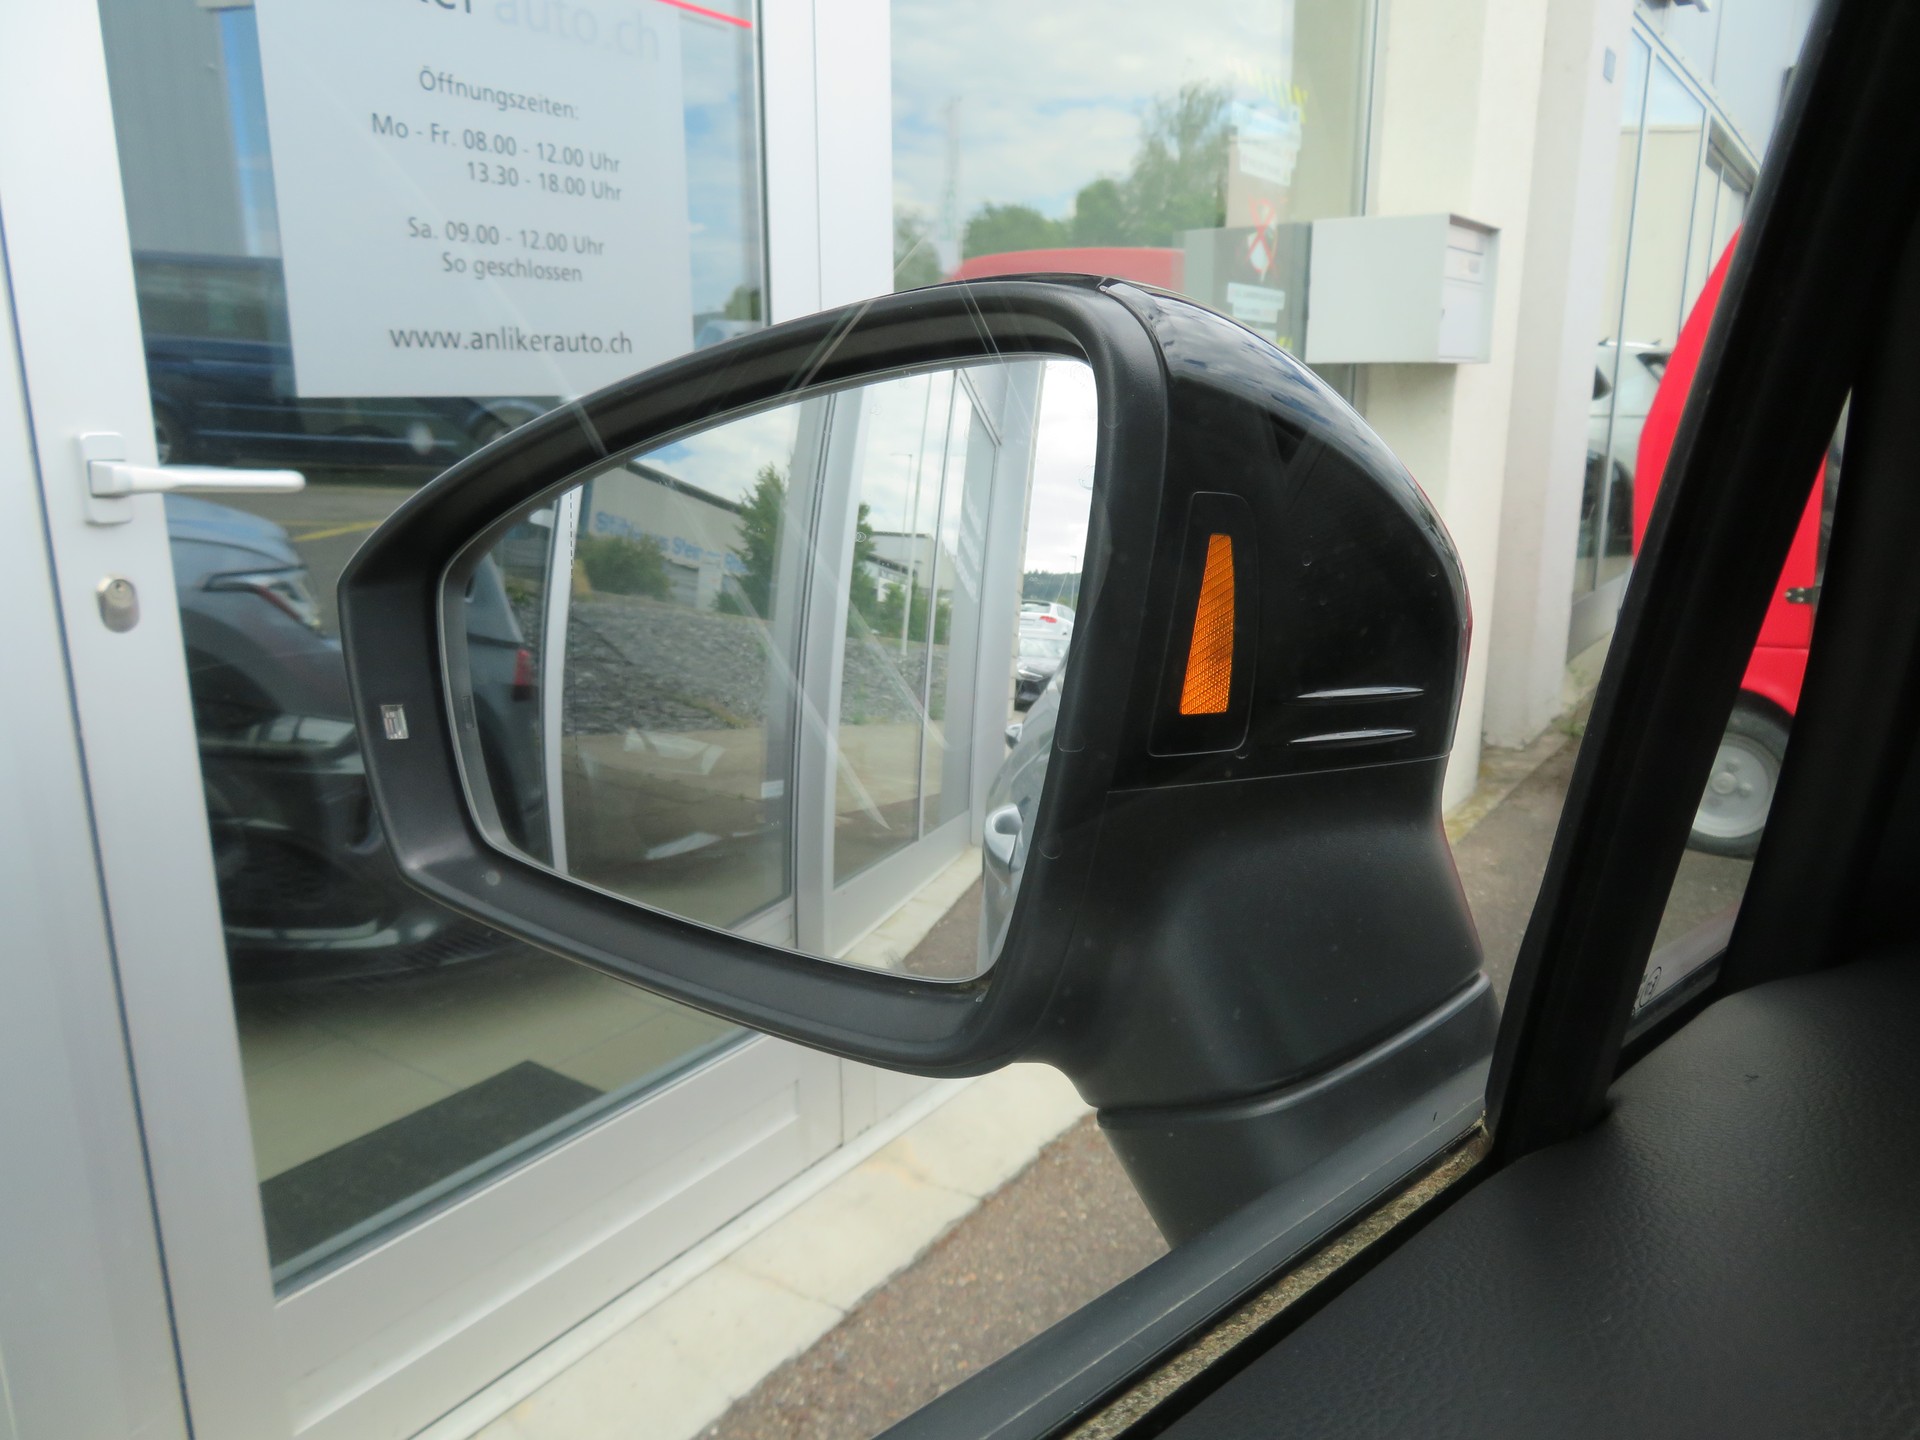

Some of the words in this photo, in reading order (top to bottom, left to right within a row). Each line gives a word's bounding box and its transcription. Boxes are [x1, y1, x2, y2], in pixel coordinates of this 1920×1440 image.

[419, 66, 579, 120] Öffnungszeiten:
[371, 113, 408, 139] Mo
[430, 123, 456, 147] Fr.
[463, 129, 517, 156] 08.00
[537, 142, 584, 168] 12.00
[590, 152, 620, 173] Uhr
[467, 162, 518, 187] 13.30
[539, 172, 586, 197] 18.00
[592, 180, 621, 201] Uhr
[408, 217, 438, 239] Sa.
[446, 221, 500, 245] 09.00
[520, 230, 568, 253] 12.00
[574, 235, 604, 256] Uhr
[442, 252, 466, 273] So
[474, 258, 583, 282] geschlossen
[389, 326, 633, 354] www.anlikerauto.ch
